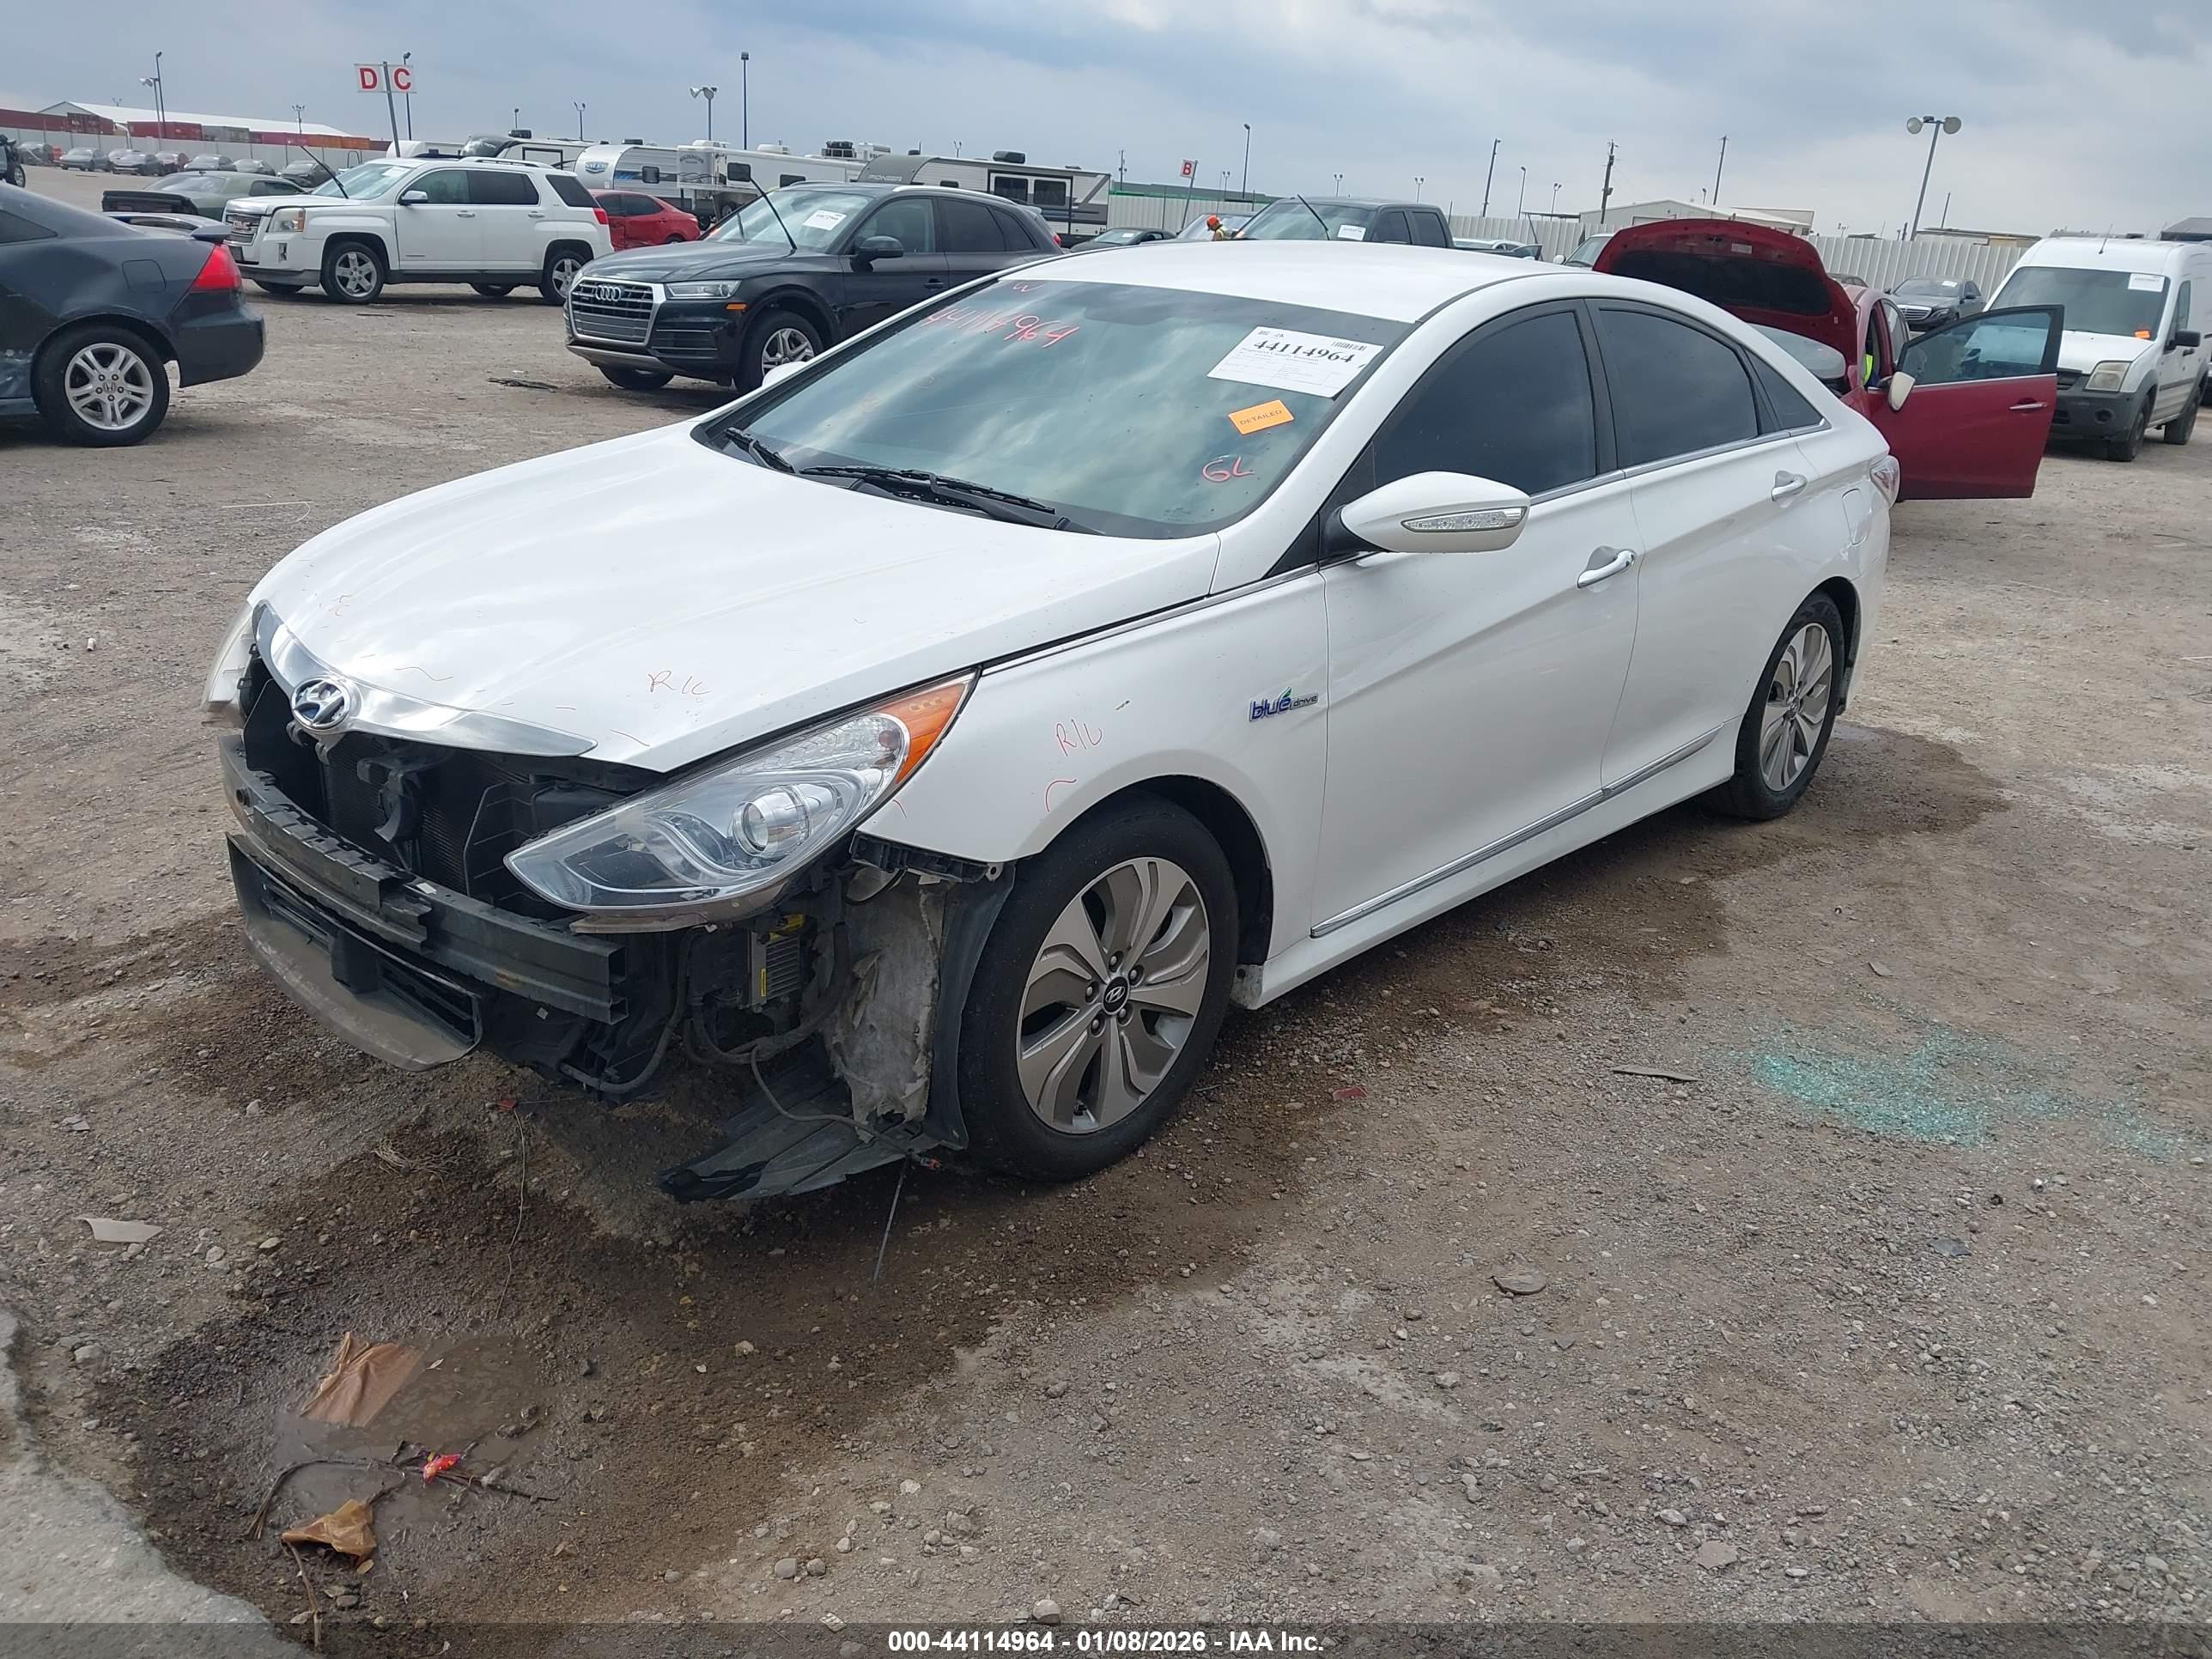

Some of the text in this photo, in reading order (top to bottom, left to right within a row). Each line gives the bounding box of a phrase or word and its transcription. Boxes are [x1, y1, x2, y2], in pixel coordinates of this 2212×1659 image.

[359, 67, 378, 89] D
[393, 67, 411, 90] C
[1182, 162, 1192, 175] B
[1254, 340, 1356, 364] 44114964
[1239, 409, 1283, 426] DETAILED
[1249, 690, 1291, 721] blue
